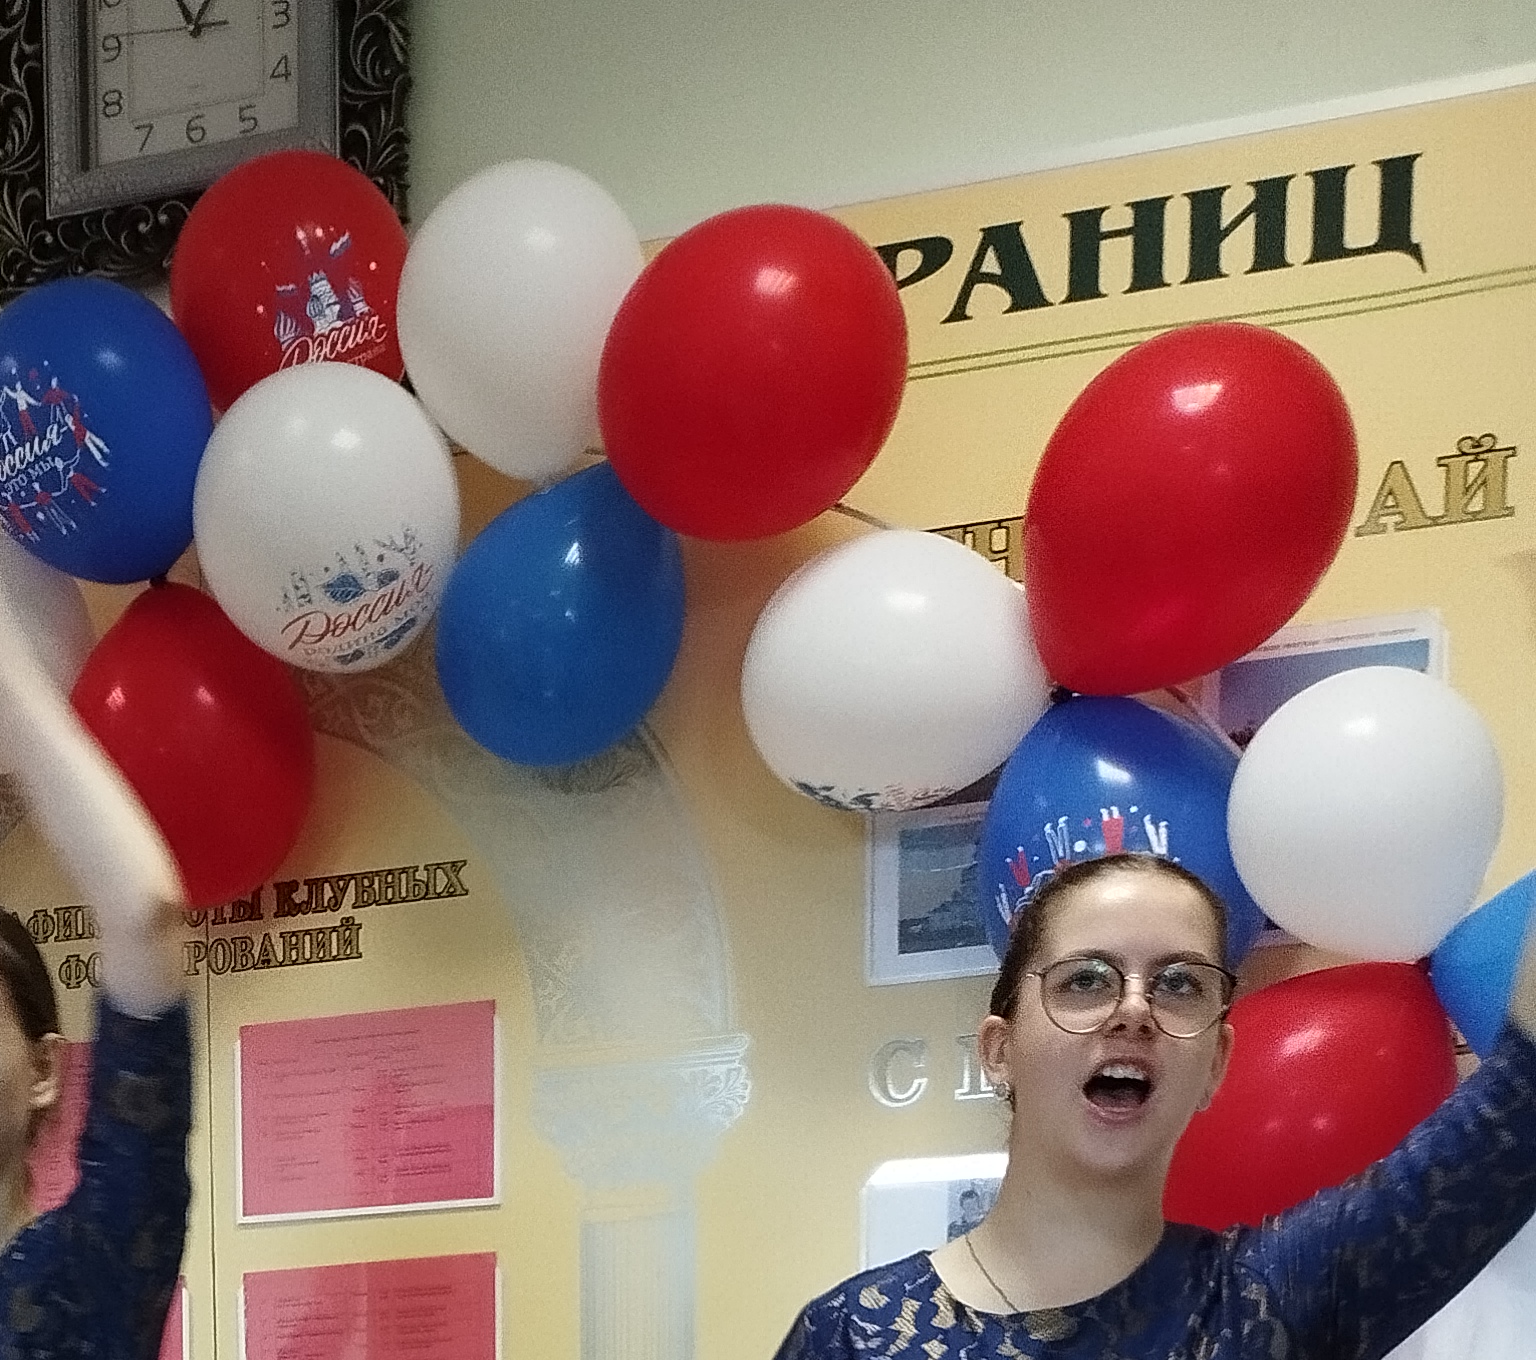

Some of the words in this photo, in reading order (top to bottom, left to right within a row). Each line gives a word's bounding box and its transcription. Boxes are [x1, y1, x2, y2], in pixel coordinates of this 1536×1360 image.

[272, 1, 290, 28] 3
[102, 33, 121, 63] 9
[270, 54, 291, 82] 4
[102, 89, 123, 118] 8
[186, 115, 206, 143] 6
[239, 104, 258, 134] 5
[134, 123, 154, 152] 7
[868, 152, 1427, 324] РАНИЦ
[281, 562, 434, 650] Россия
[274, 859, 469, 919] КЛУБНЫХ
